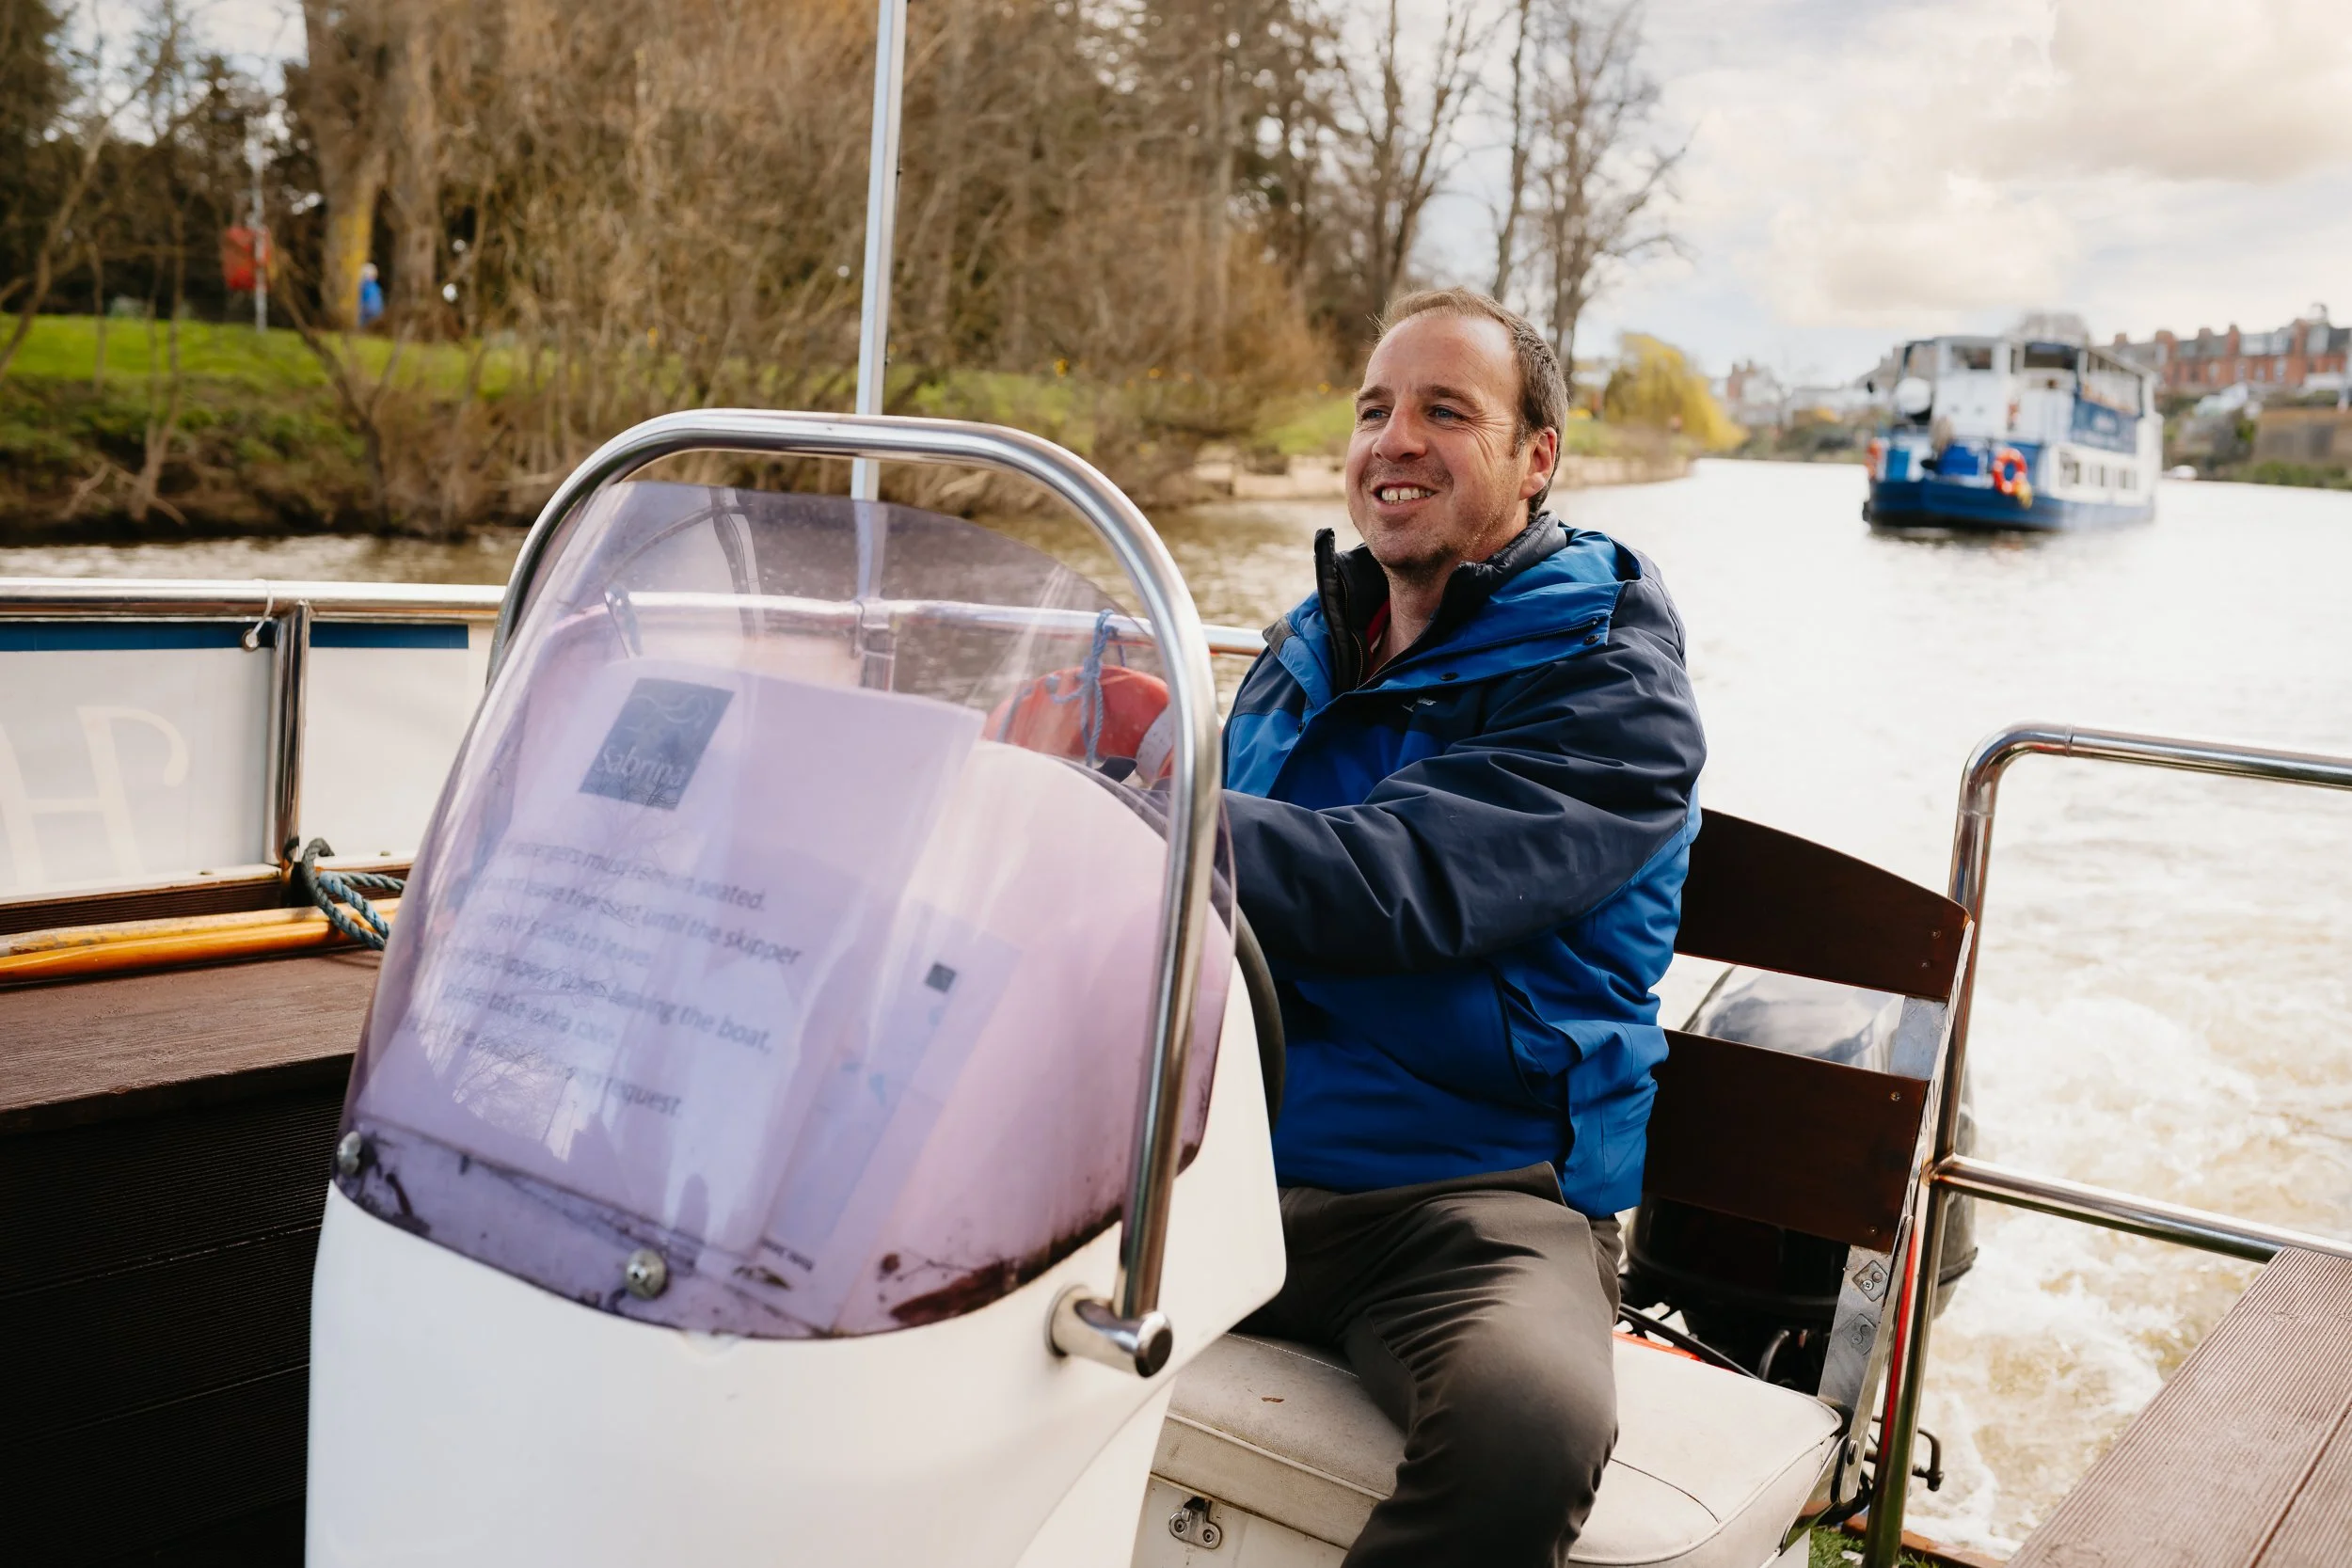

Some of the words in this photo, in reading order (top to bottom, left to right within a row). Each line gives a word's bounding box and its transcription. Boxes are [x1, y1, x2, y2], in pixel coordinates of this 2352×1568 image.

[687, 916, 723, 944] the
[722, 927, 803, 965] skipper
[678, 1005, 716, 1033] the
